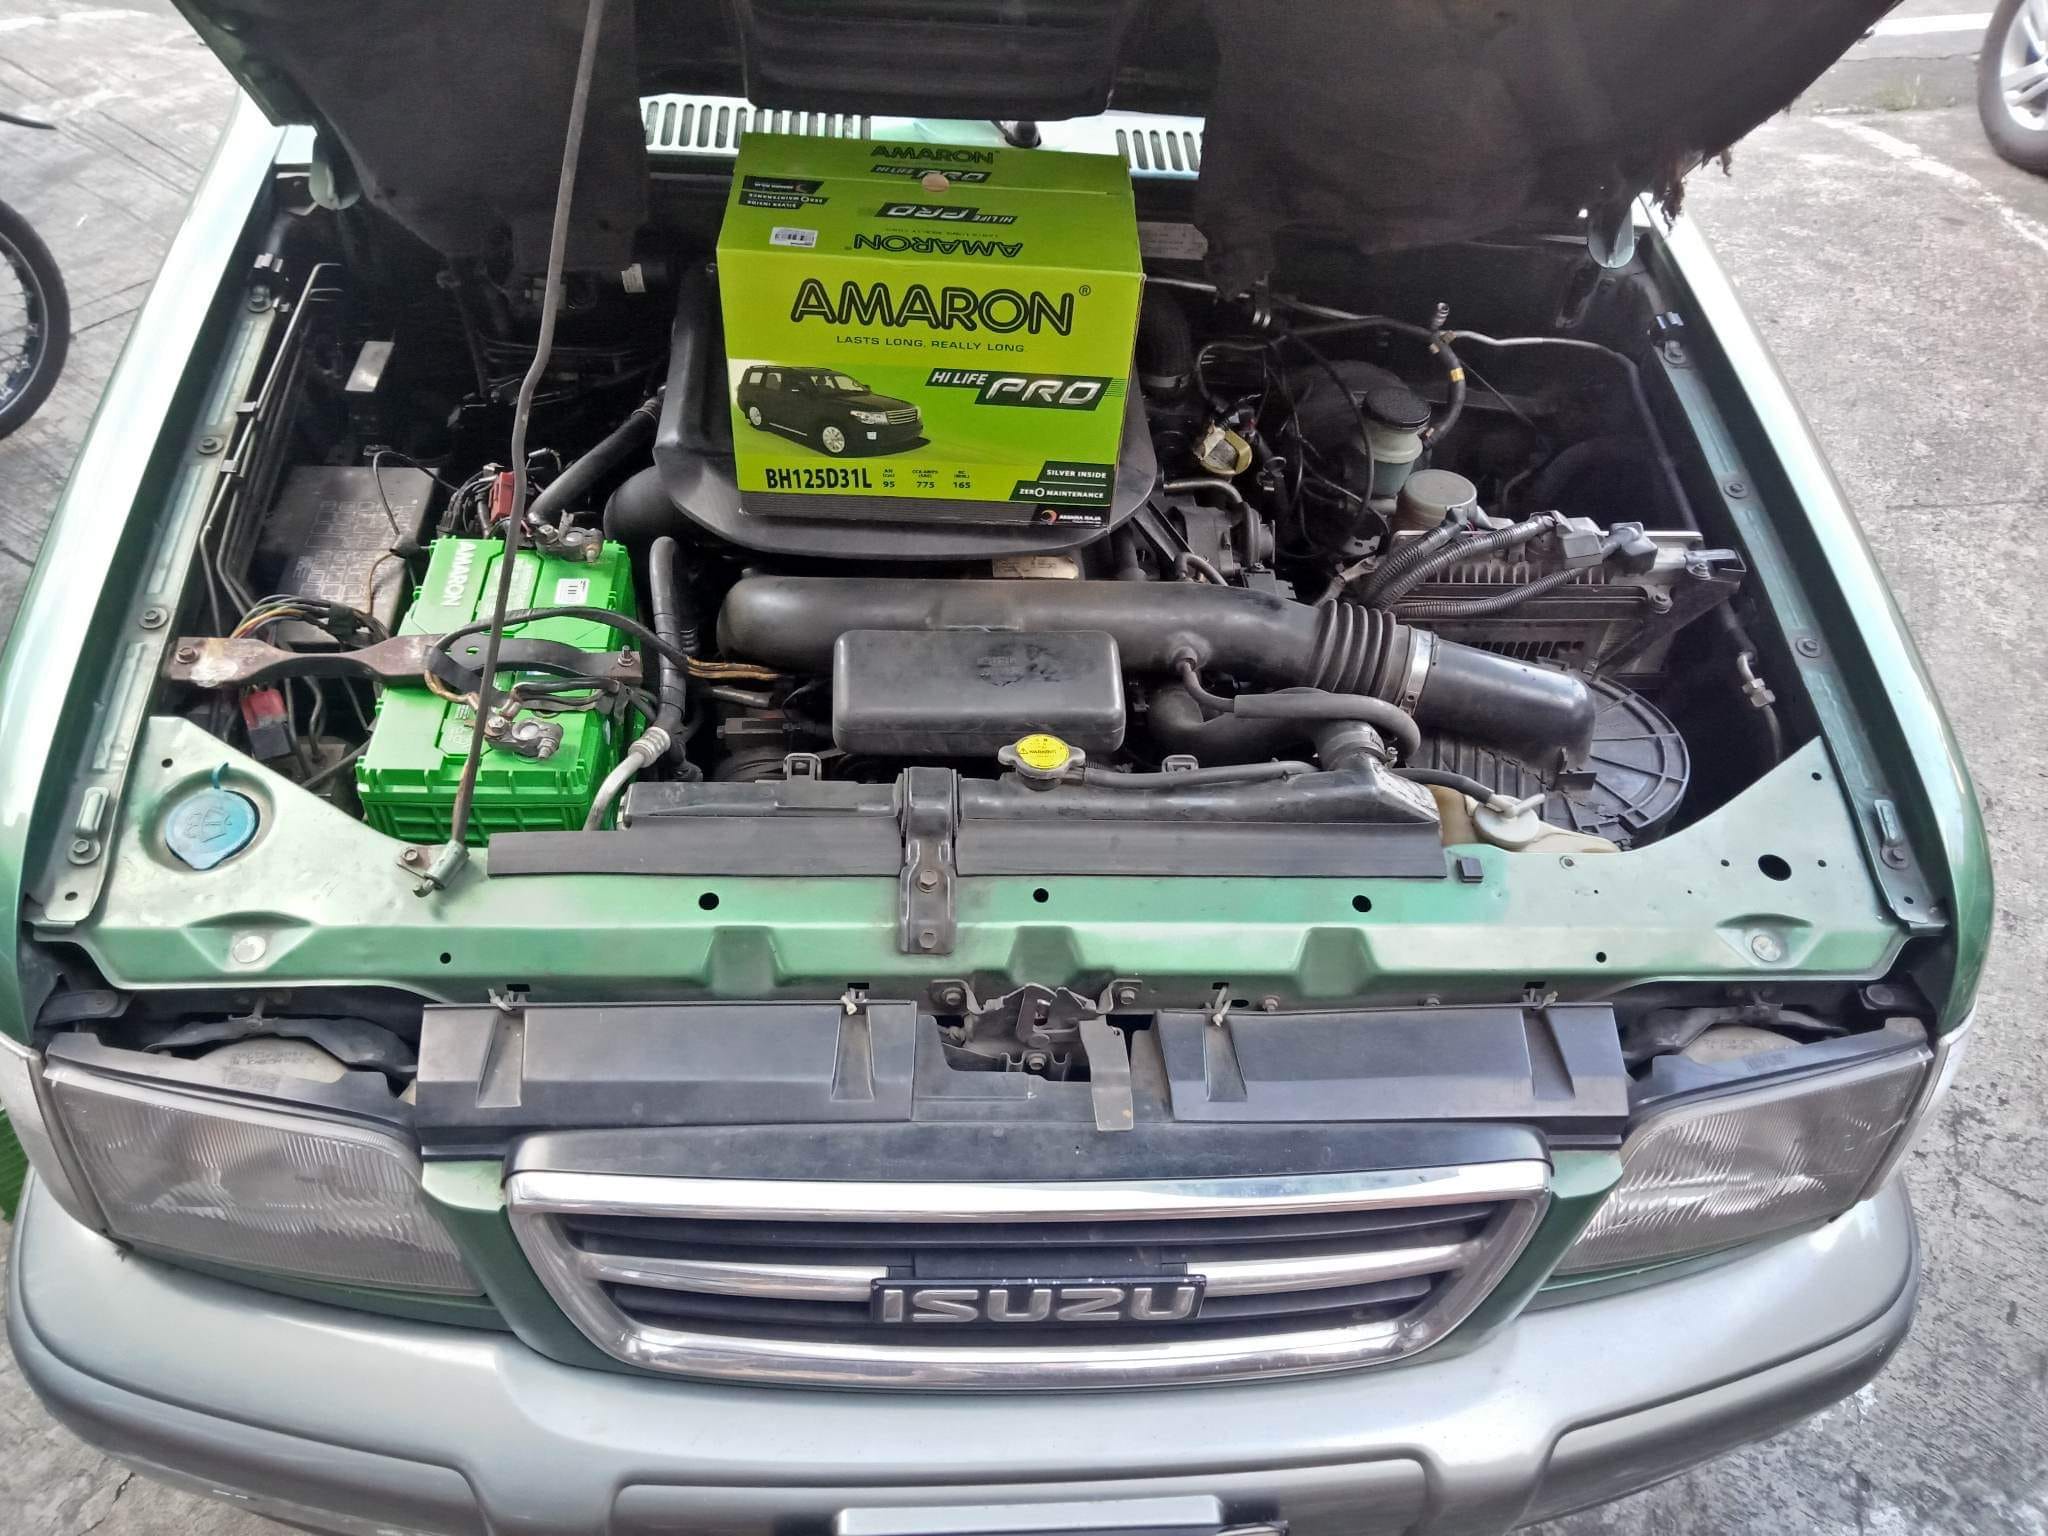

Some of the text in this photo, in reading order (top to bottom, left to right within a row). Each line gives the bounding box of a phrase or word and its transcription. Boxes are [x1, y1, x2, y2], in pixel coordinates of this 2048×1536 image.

[870, 145, 993, 164] AMARON
[887, 205, 969, 219] PRO
[854, 233, 1023, 257] AMARON
[791, 278, 1074, 336] AMARON
[836, 335, 880, 345] LASTS
[931, 341, 981, 351] REALLY
[987, 343, 1024, 352] LONG
[931, 371, 1101, 405] HI LIFE PRO
[765, 468, 873, 489] BH125D31L
[1046, 469, 1107, 479] SILVER INSIDE
[916, 481, 935, 489] 775
[952, 481, 971, 489] 165
[1019, 487, 1104, 499] ZERO MAINTENANCE
[440, 541, 477, 607] AMARON
[883, 1287, 1196, 1323] ISUZU
